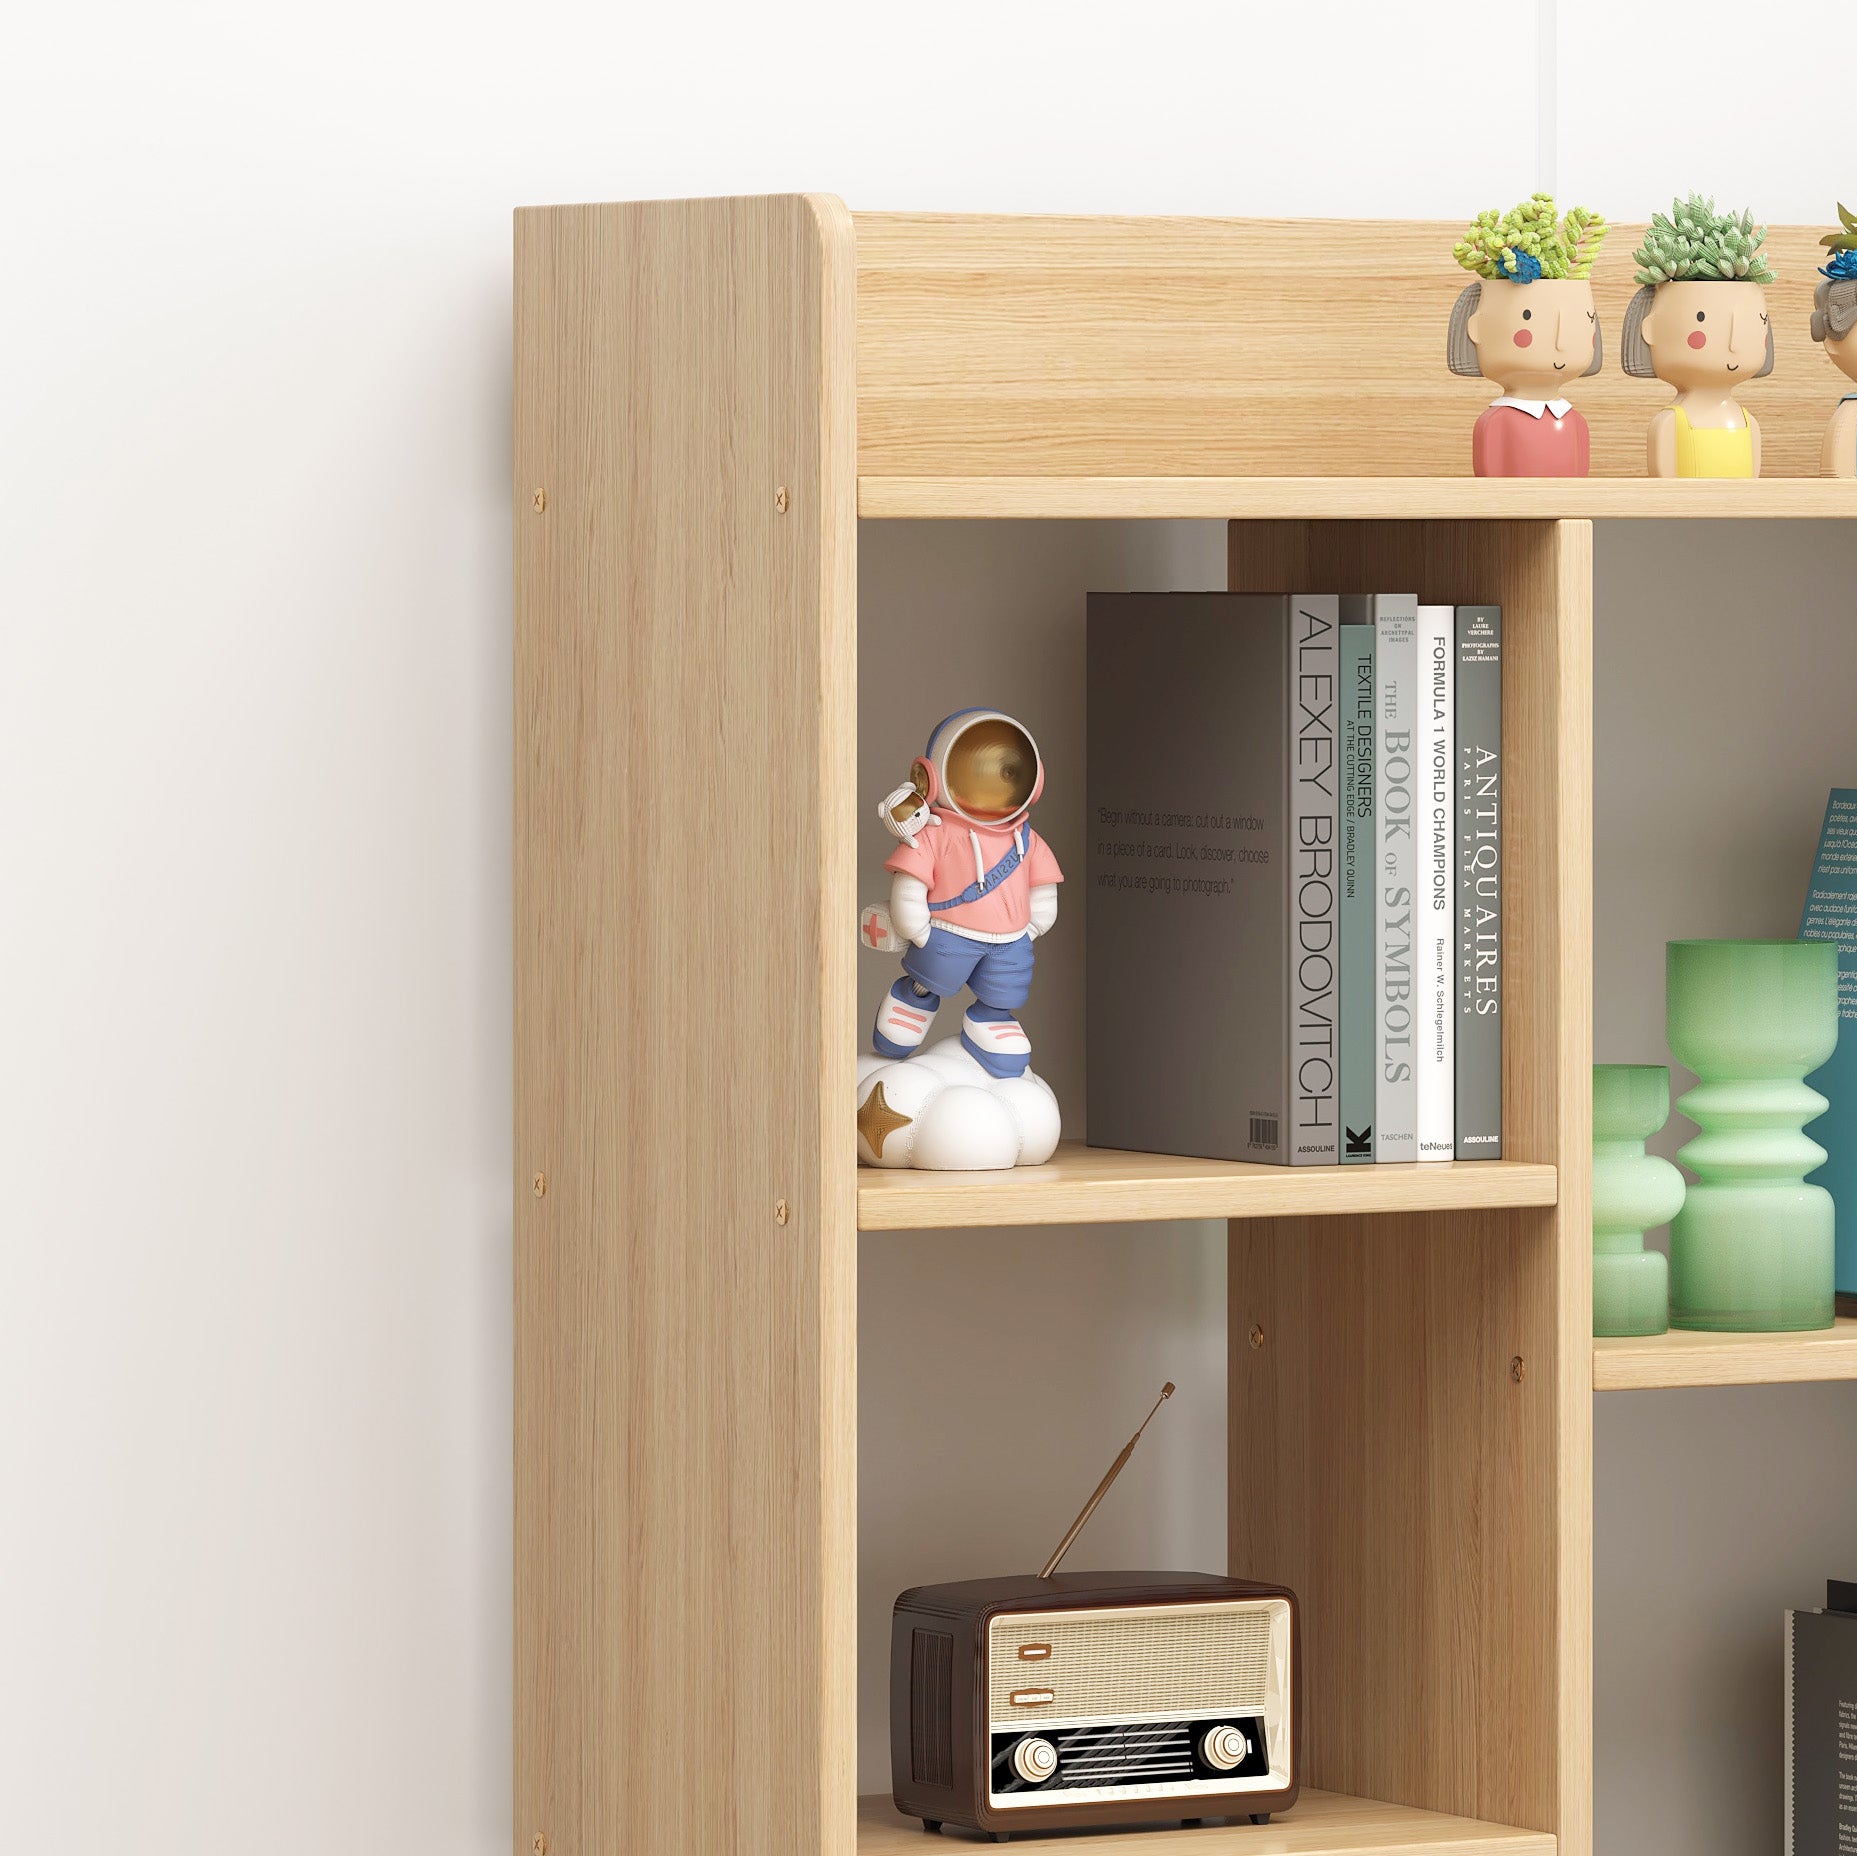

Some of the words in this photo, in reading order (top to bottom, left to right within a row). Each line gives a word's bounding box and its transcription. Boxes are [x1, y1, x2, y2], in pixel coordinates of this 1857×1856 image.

[1357, 654, 1372, 718] TEXTILE
[1384, 680, 1397, 720] THE
[1432, 636, 1446, 721] FORMULA
[1298, 610, 1333, 796] ALEXEY
[1346, 719, 1355, 732] AT
[1346, 733, 1355, 752] THE
[1433, 725, 1445, 733] 1
[1346, 753, 1355, 792] CUTTING
[1357, 726, 1372, 817] DESIGNERS
[1384, 729, 1411, 842] BOOK
[1433, 739, 1446, 803] WORLD
[1463, 747, 1472, 815] PARIS
[1346, 794, 1355, 818] EDGE
[1346, 825, 1355, 867] BRADLEY
[1384, 852, 1398, 877] OF
[1433, 807, 1446, 911] CHAMPIONS
[1463, 835, 1473, 888] FLEA
[1346, 868, 1355, 898] QUINN
[1471, 746, 1498, 1014] ANTIQUAIRES
[1298, 816, 1333, 1126] BRODOVITCH
[1436, 938, 1445, 972] Rainer
[1463, 908, 1472, 1014] MARKETS
[1384, 888, 1411, 1083] SYMBOLS
[1436, 974, 1445, 988] W.
[1434, 990, 1445, 1063] Schlegelmilch
[1297, 1144, 1335, 1153] ASSOULINE
[1380, 1133, 1414, 1141] TASCHEN
[1463, 1135, 1499, 1144] ASSOULINE
